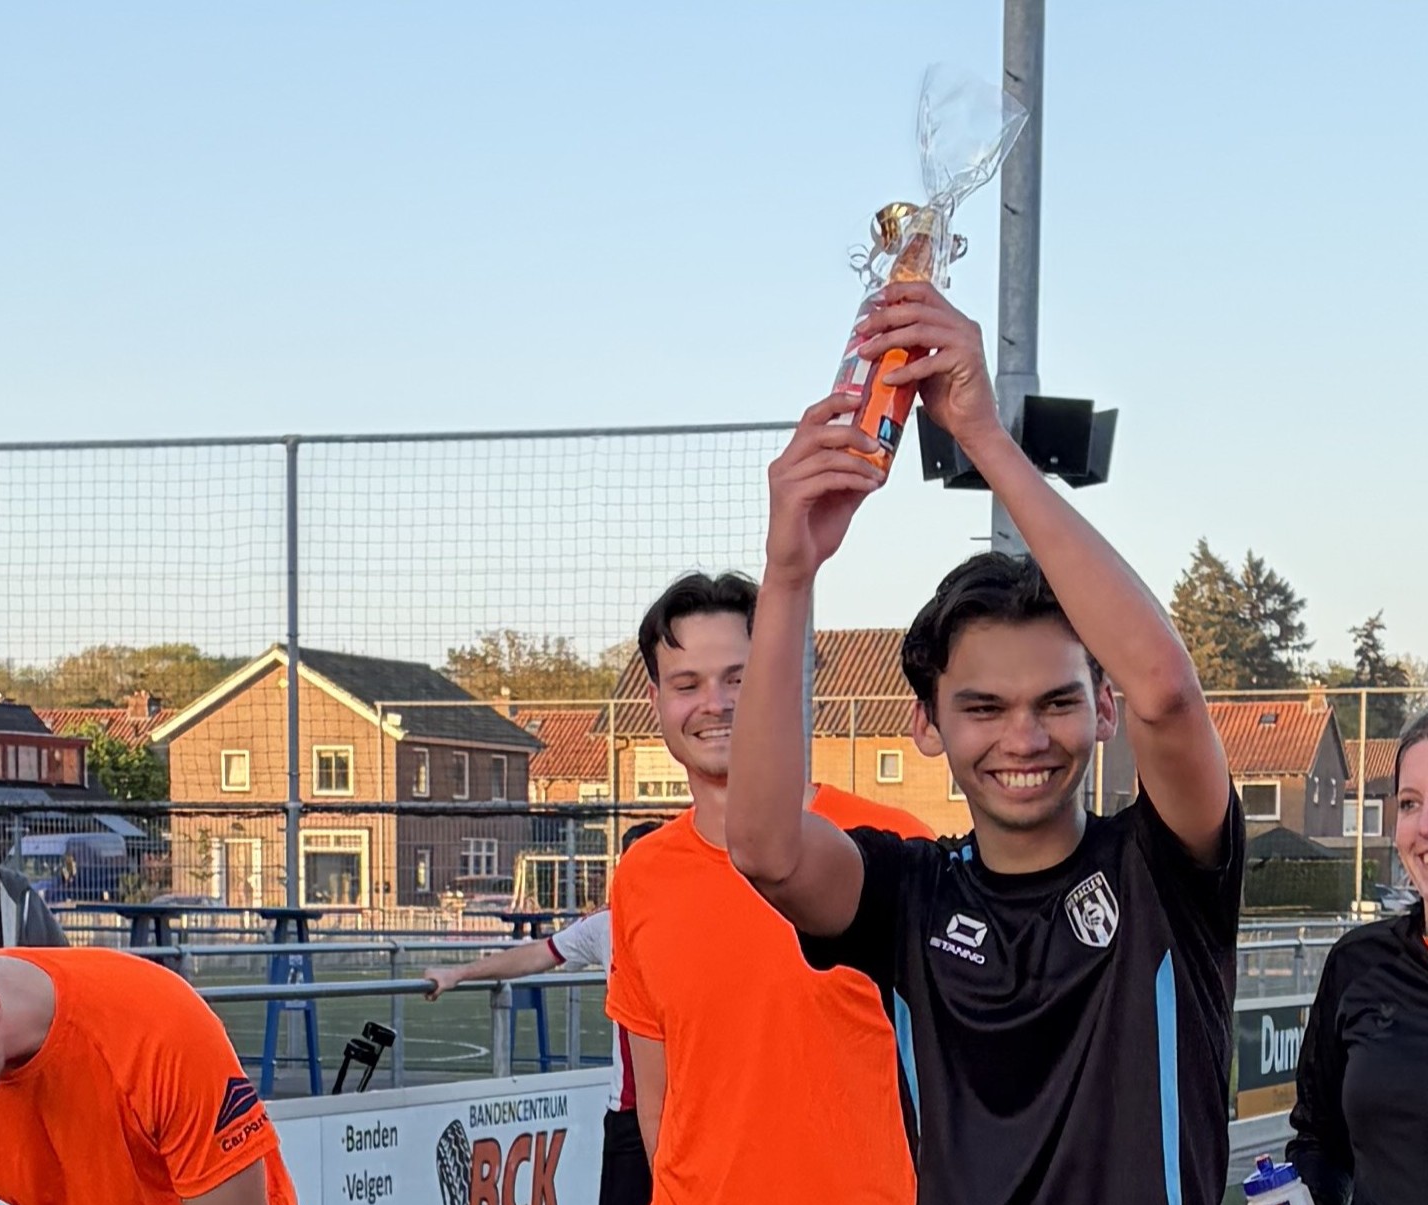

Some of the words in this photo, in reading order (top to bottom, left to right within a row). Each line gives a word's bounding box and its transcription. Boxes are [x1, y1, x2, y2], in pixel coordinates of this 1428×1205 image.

[930, 937, 985, 965] STANNO
[1260, 1014, 1307, 1075] Dum
[469, 1094, 569, 1129] BANDENCENTRUM
